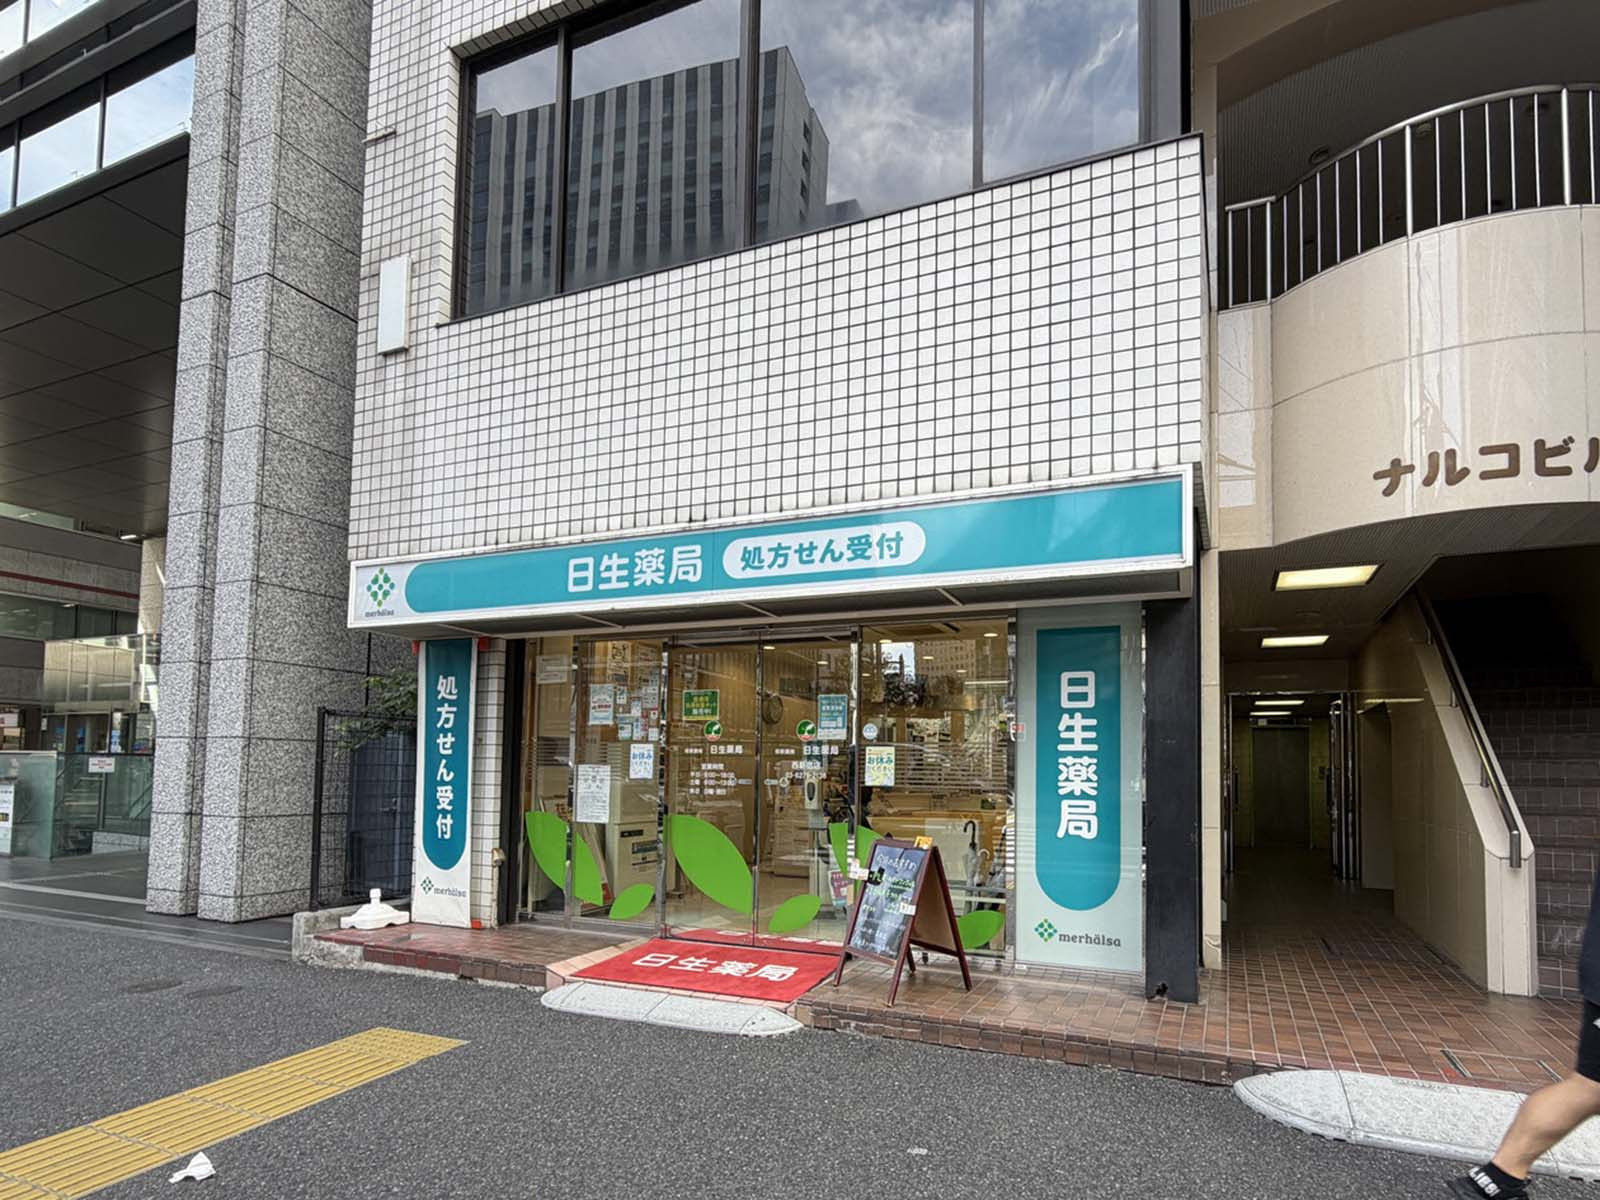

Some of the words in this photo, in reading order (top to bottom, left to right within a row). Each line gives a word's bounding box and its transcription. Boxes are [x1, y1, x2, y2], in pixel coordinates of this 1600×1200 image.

[567, 544, 703, 593] 日生薬局
[740, 531, 903, 571] 処方せん受付
[436, 675, 458, 840] 処方せん受付
[1057, 670, 1098, 839] 日生薬局
[434, 886, 466, 897] merhälsa
[1058, 932, 1121, 947] merhälsa
[632, 953, 799, 982] 日生薬局
